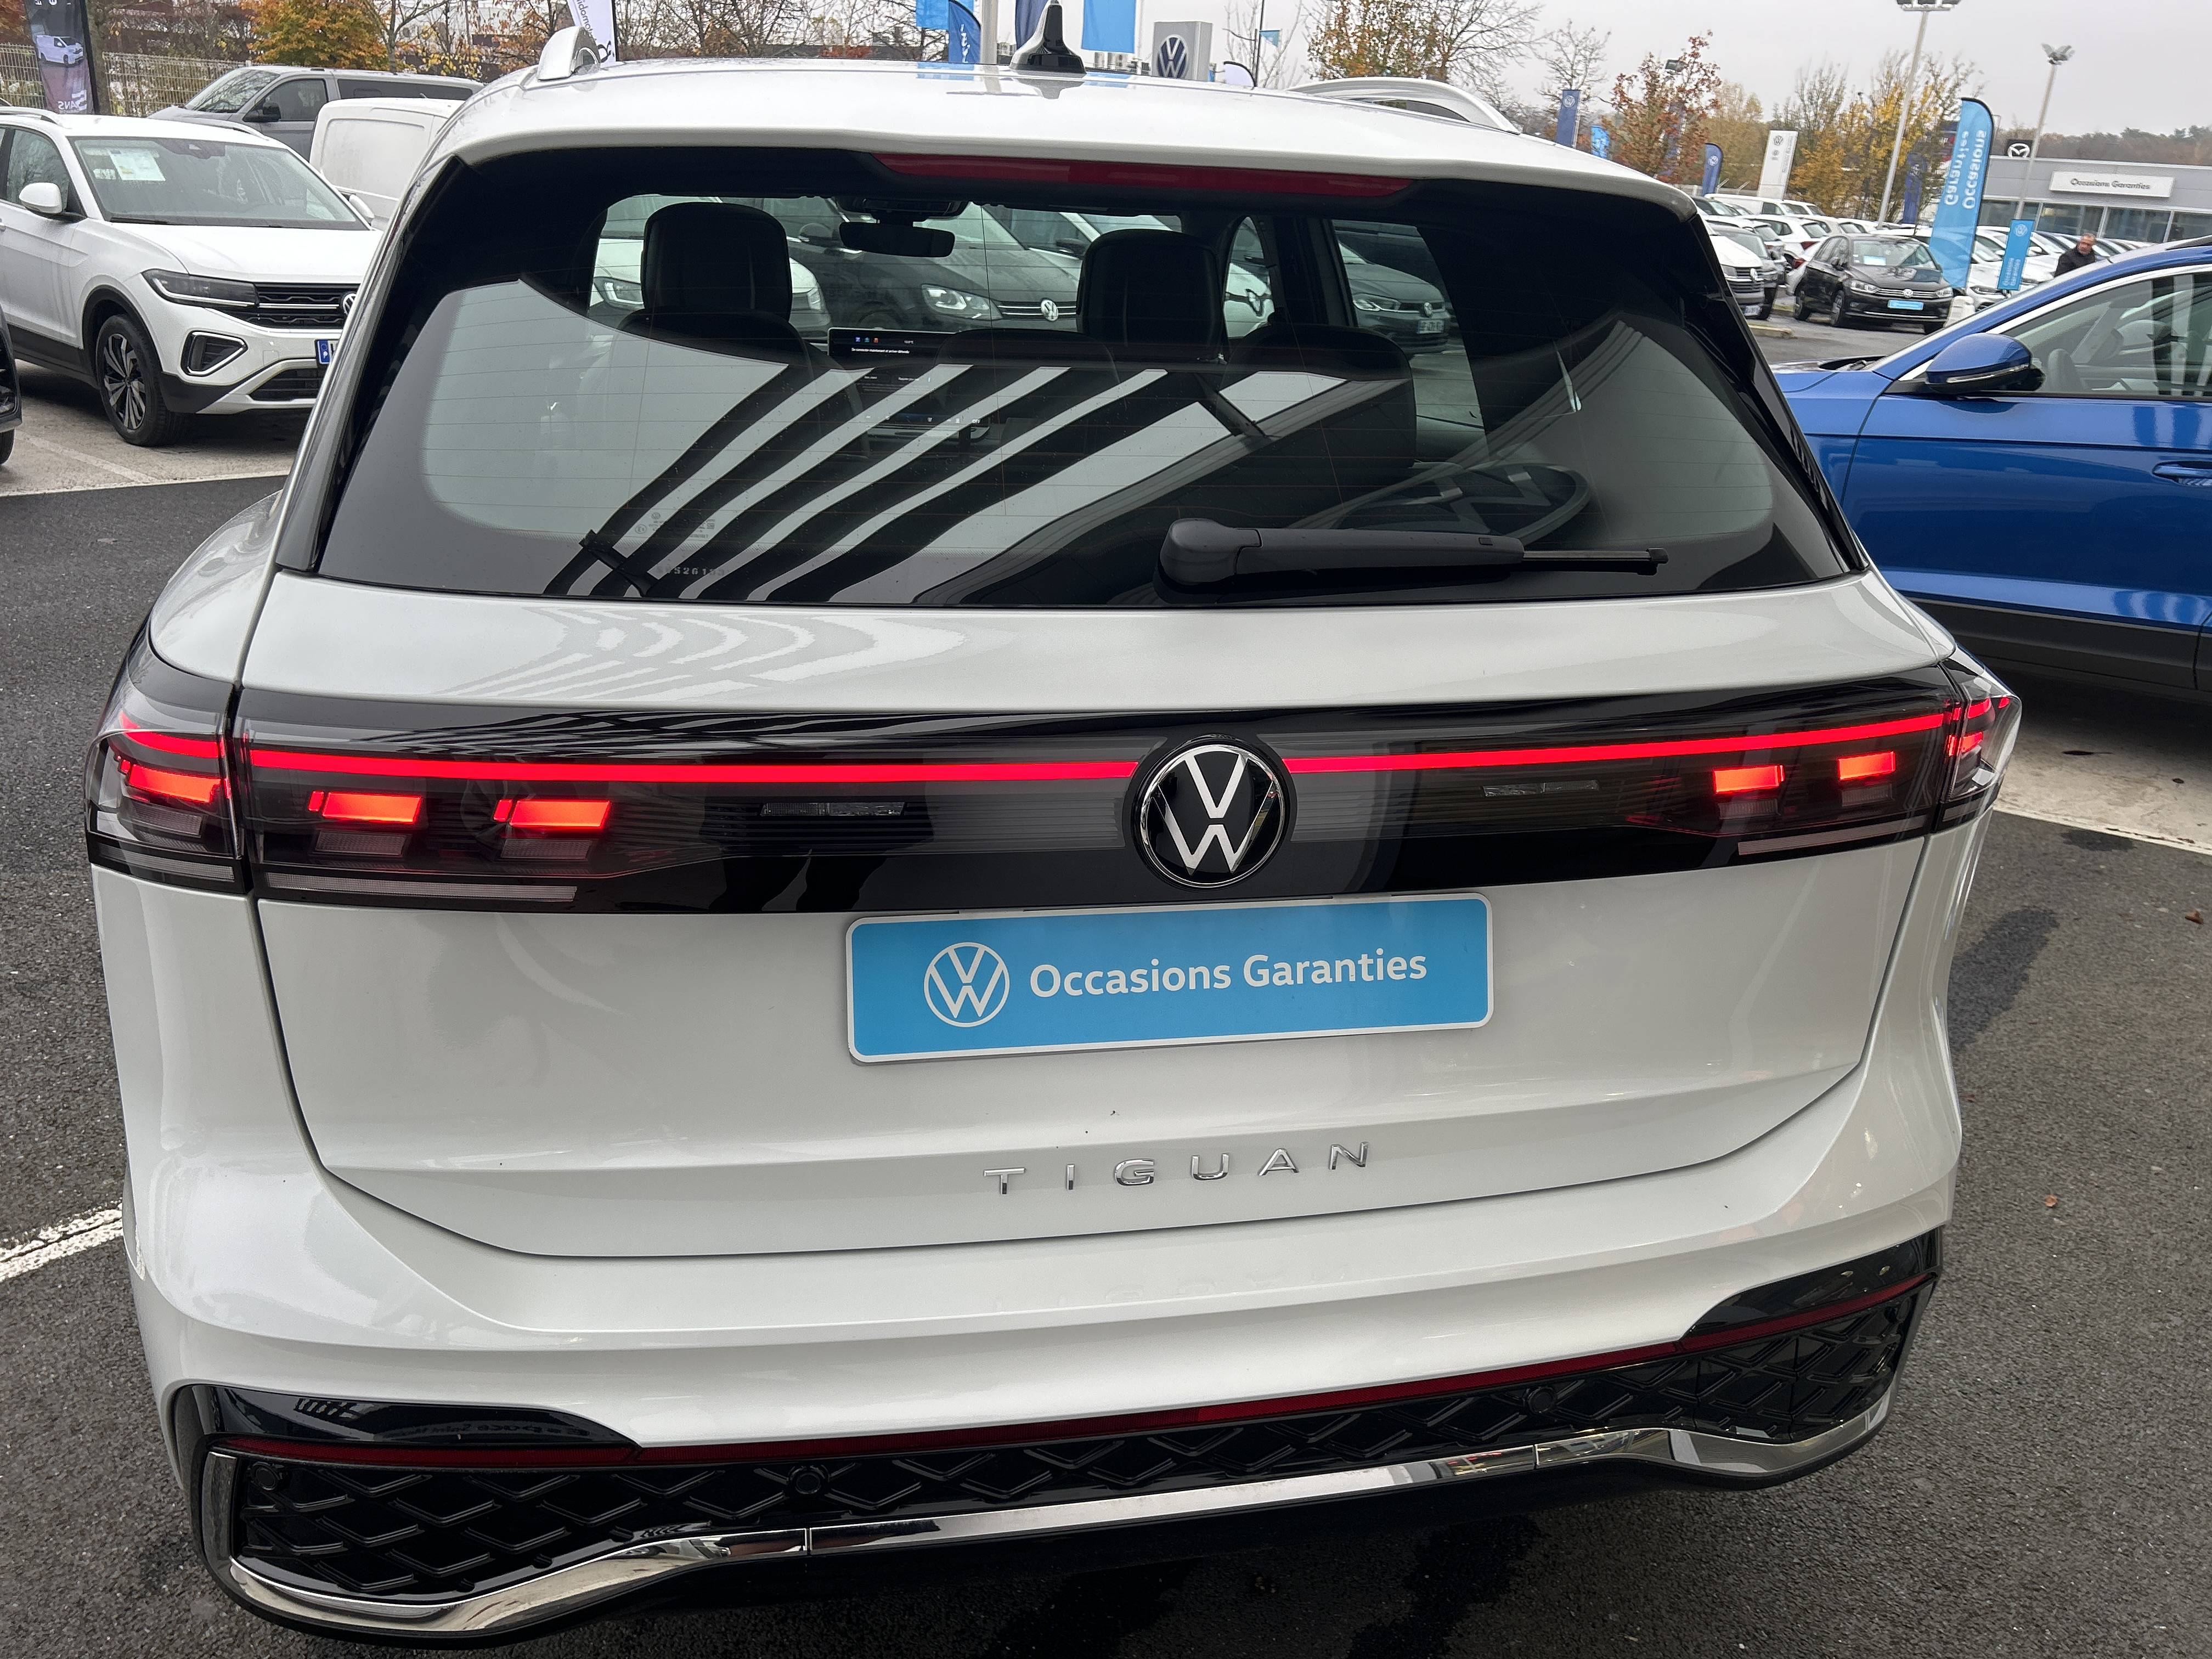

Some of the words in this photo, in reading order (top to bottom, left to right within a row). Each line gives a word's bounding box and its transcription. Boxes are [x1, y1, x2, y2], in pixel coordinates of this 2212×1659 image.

[2070, 178, 2111, 188] Occasions
[1030, 958, 1231, 997] Occasions
[1243, 948, 1427, 987] Garanties
[983, 1141, 1370, 1196] TIGUAN
